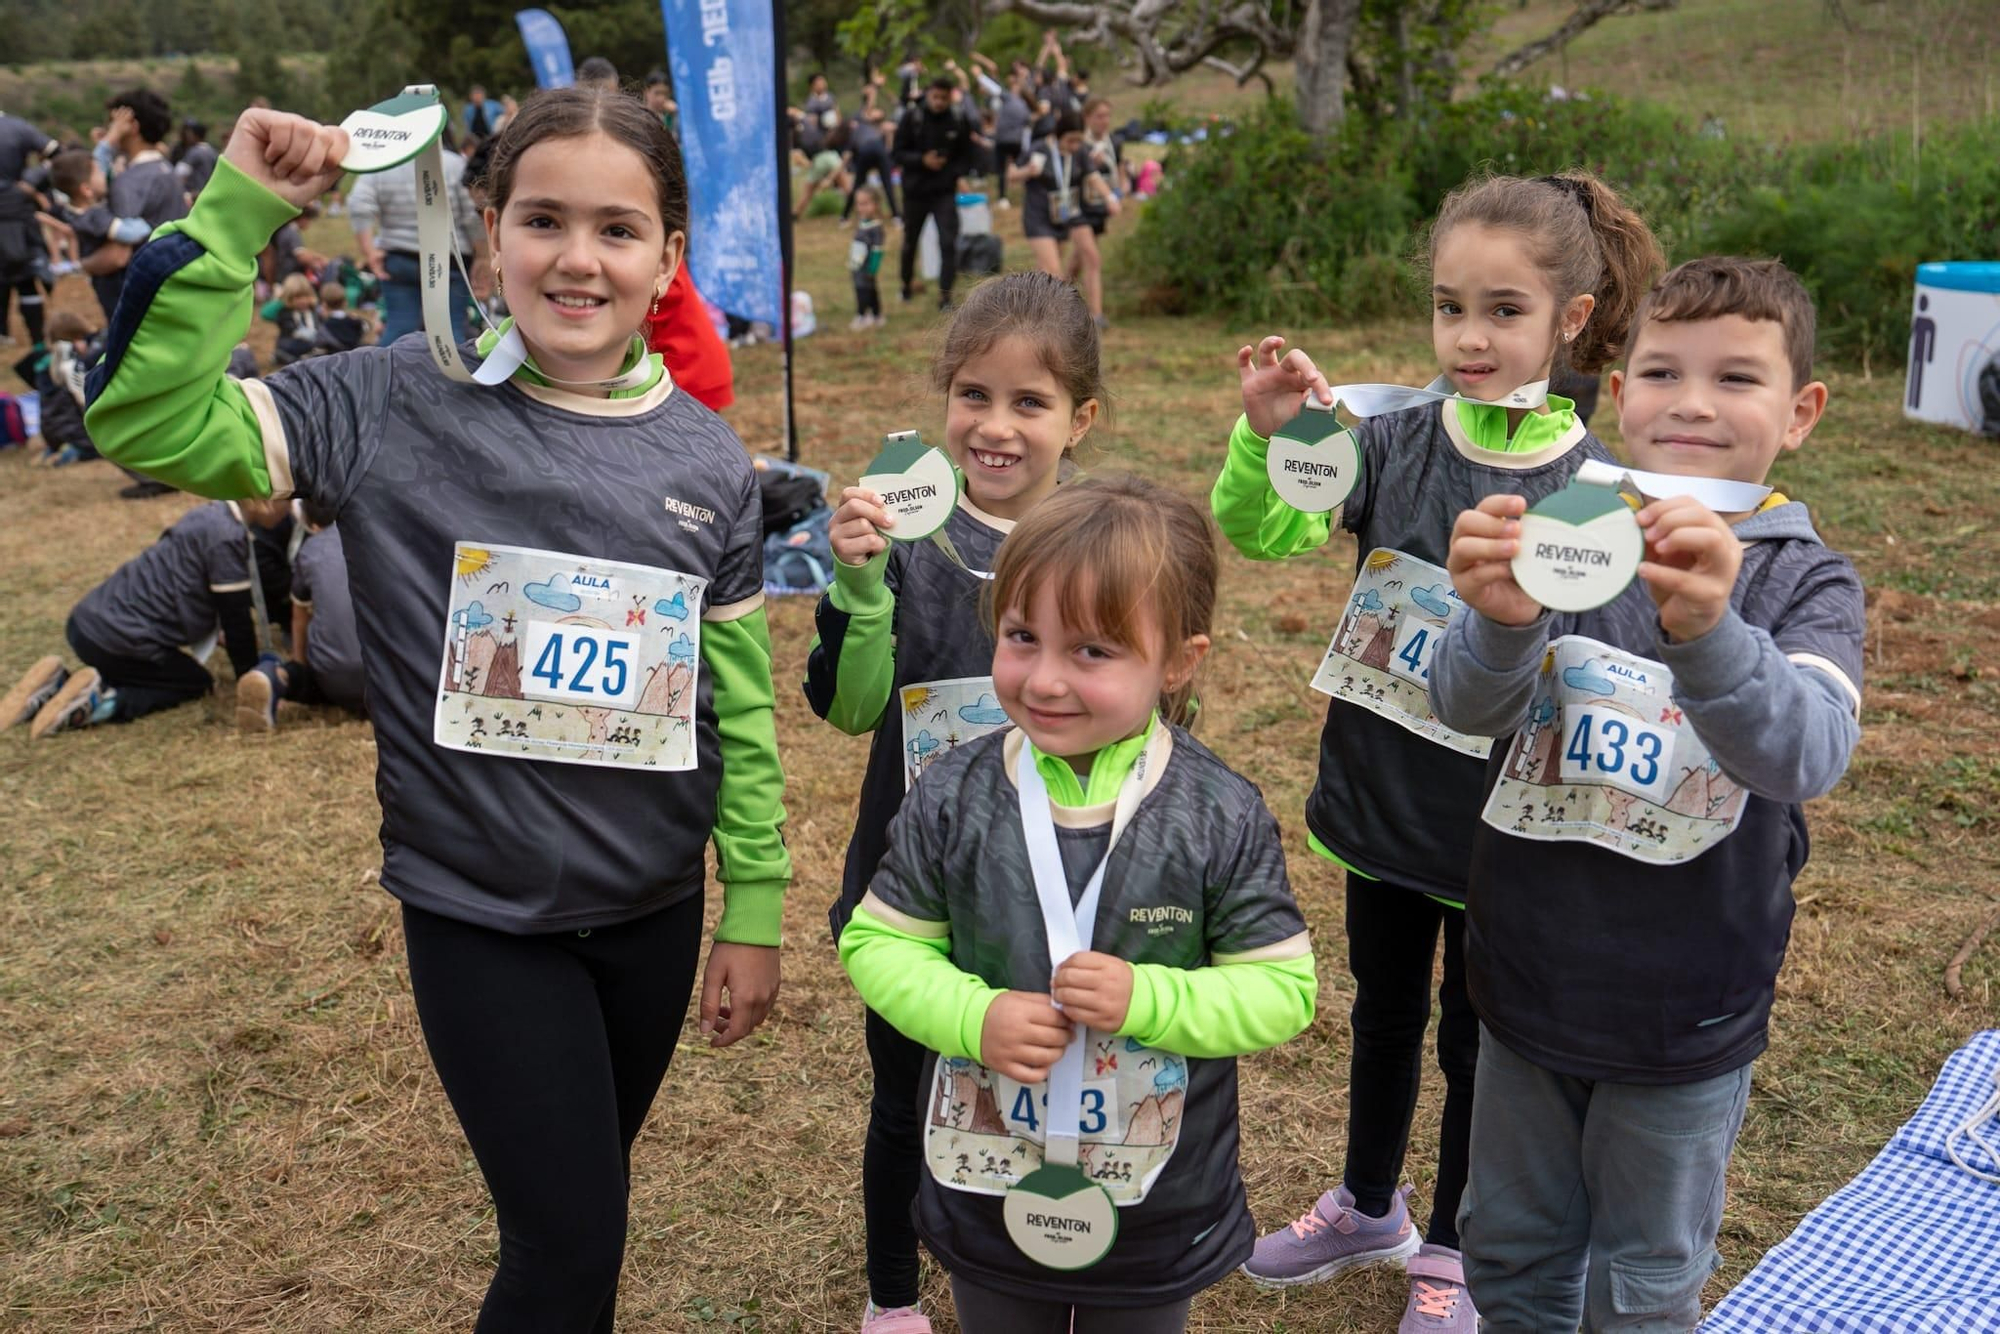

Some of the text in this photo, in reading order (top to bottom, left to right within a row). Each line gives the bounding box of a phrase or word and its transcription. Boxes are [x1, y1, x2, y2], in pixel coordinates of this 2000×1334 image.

[571, 574, 611, 589] AULA
[531, 632, 630, 697] 425
[1607, 664, 1648, 684] AULA
[1566, 714, 1663, 786] 433
[1010, 1085, 1107, 1134] 43
